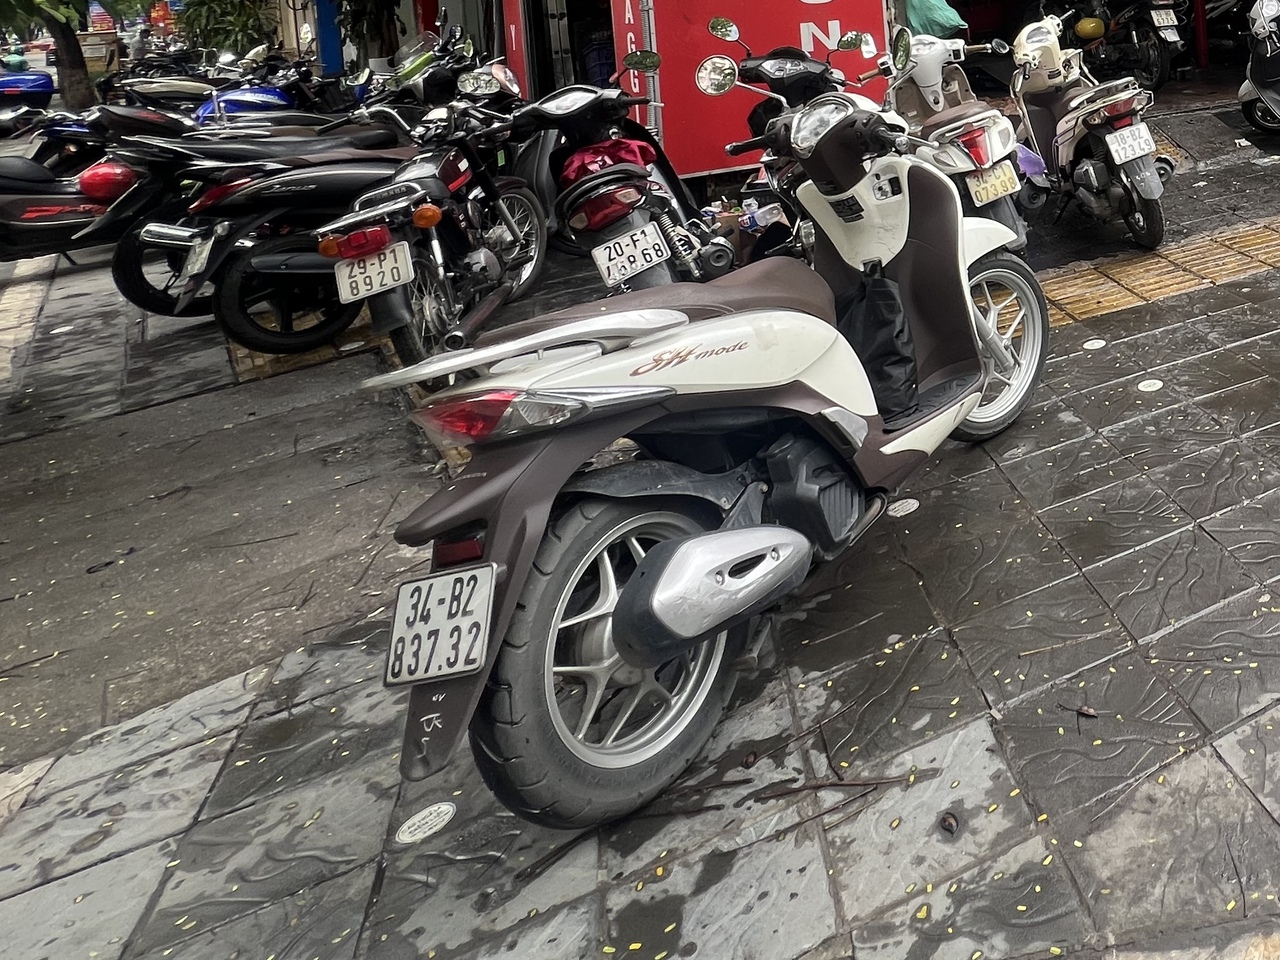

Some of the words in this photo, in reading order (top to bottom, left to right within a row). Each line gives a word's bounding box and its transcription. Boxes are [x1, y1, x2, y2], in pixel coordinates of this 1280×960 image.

[1113, 126, 1144, 147] 18-B2
[1115, 138, 1153, 162] 123.49
[603, 229, 648, 263] 20-F1
[345, 248, 398, 280] 29-P1
[349, 266, 401, 297] 8920
[694, 339, 749, 360] mode
[405, 573, 479, 629] 34-B2
[390, 620, 482, 680] 837.32
